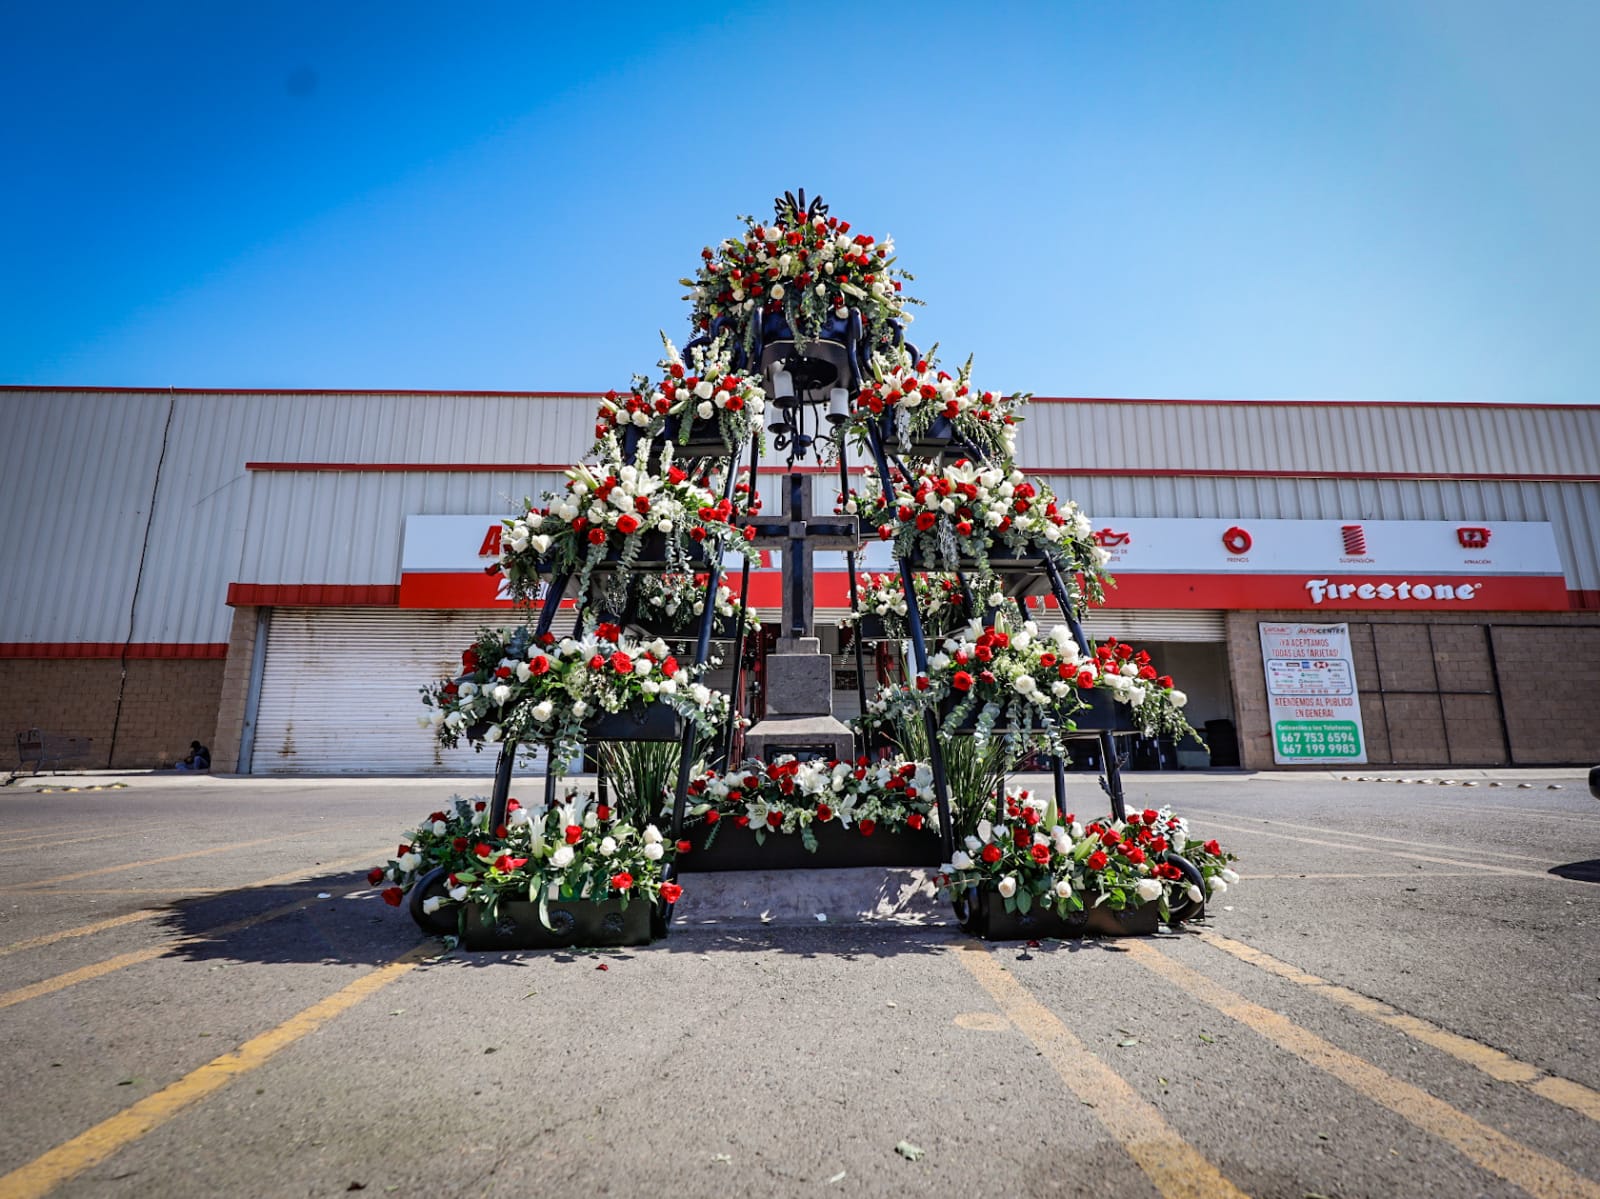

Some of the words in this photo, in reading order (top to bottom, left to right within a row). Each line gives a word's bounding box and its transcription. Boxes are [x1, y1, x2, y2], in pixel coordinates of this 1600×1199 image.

[1305, 578, 1476, 604] Firestone
[1291, 638, 1329, 647] ACEPTAMOS
[1272, 648, 1291, 657] TODAS
[1293, 648, 1305, 657] LAS
[1275, 697, 1314, 706] ATENDEMOS
[1315, 697, 1323, 707] AL
[1295, 709, 1304, 717] EN
[1305, 709, 1335, 718] GENERAL
[1281, 732, 1301, 743] 667
[1303, 732, 1324, 743] 753
[1327, 732, 1355, 743] 6594
[1283, 743, 1302, 754] 667
[1305, 743, 1325, 754] 199
[1328, 743, 1356, 754] 9983
